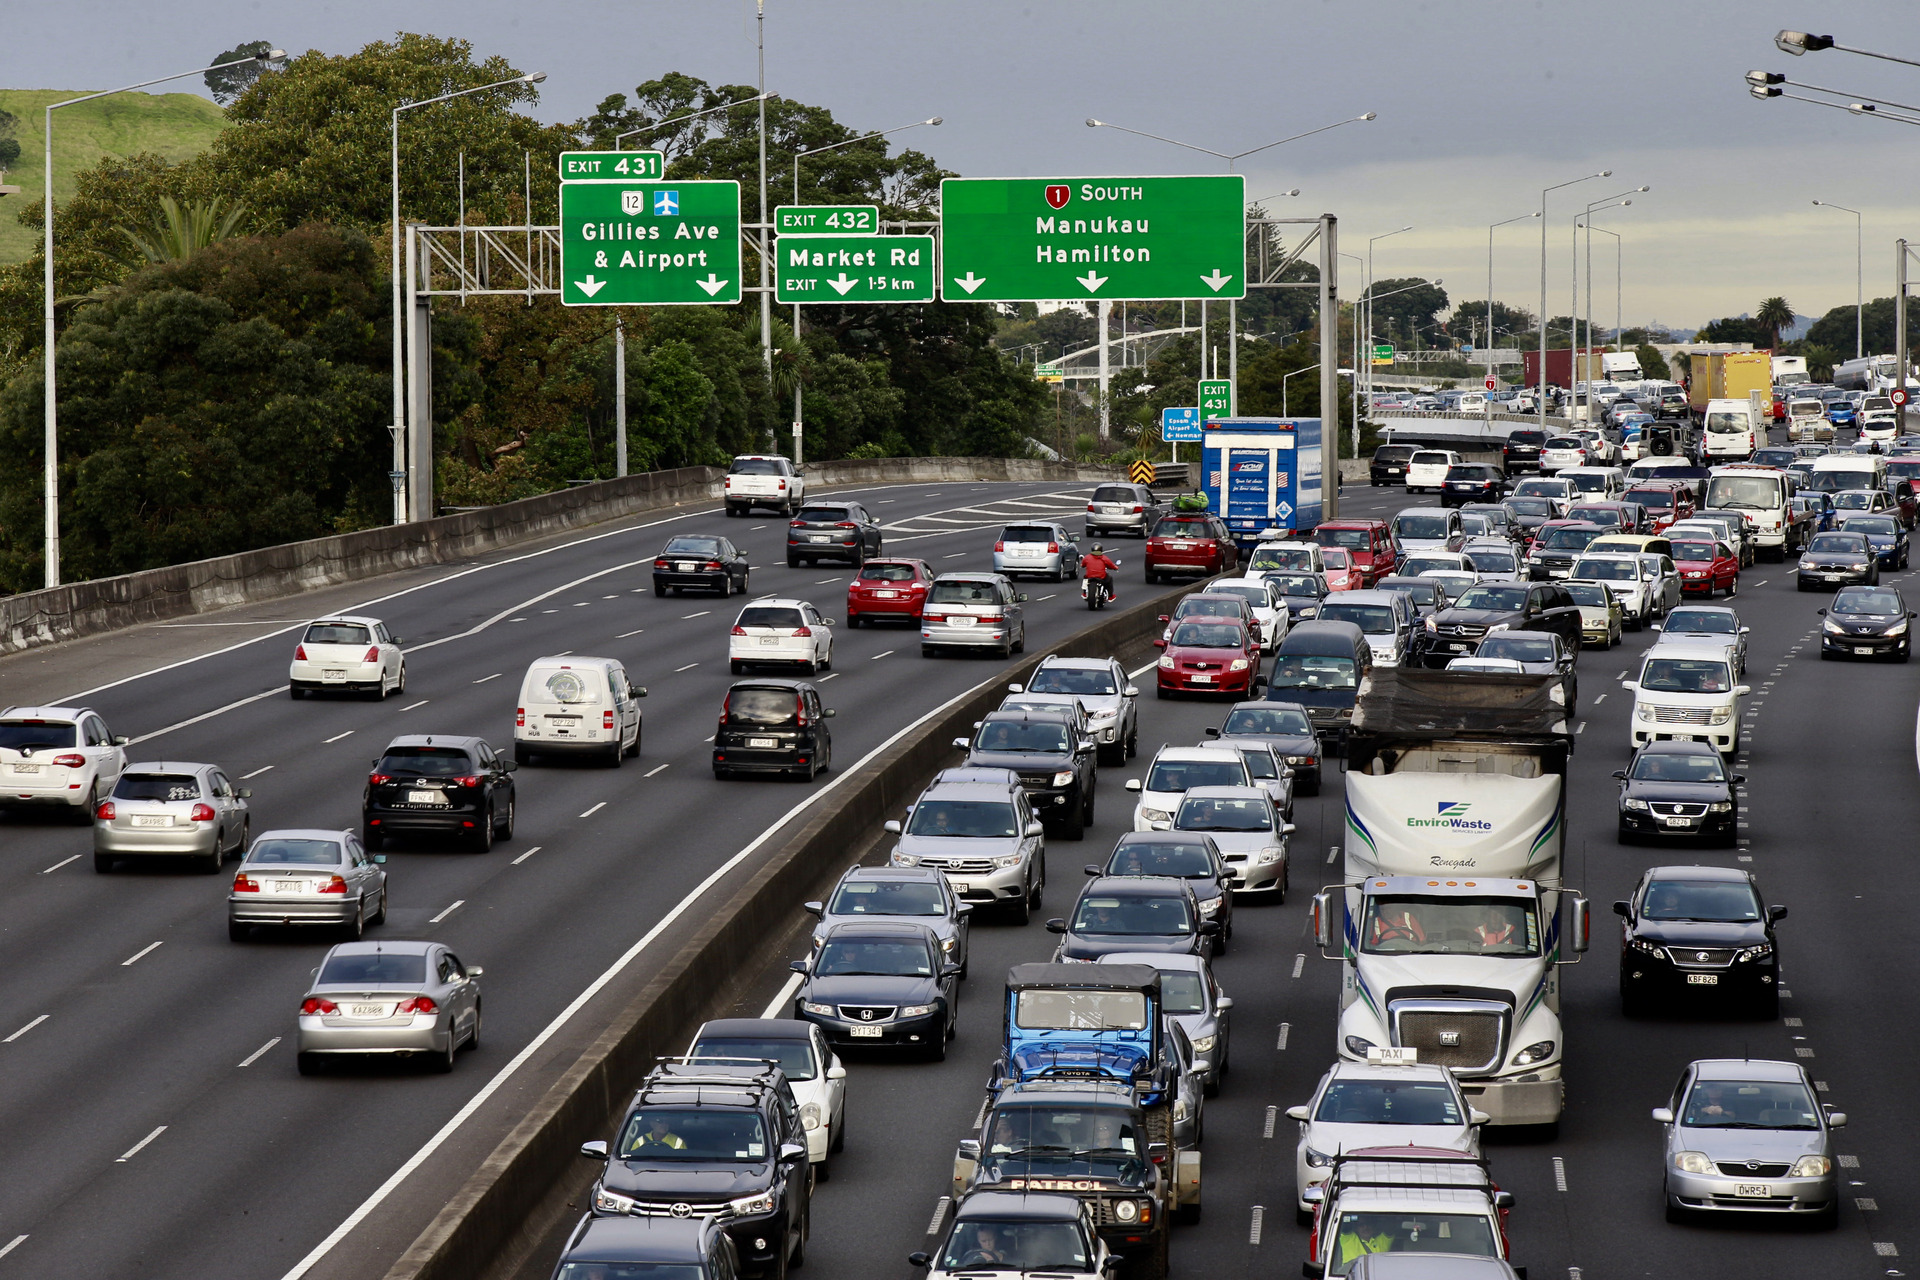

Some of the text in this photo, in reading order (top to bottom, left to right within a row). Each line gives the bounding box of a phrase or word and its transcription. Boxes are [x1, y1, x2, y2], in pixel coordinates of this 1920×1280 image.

[568, 157, 656, 175] EXIT 431
[626, 195, 639, 209] 12
[1055, 188, 1061, 202] 1
[783, 212, 871, 229] EXIT 432
[1036, 216, 1149, 234] Manukau
[582, 222, 720, 241] Gillies Ave
[594, 250, 708, 272] & Airport
[789, 248, 920, 267] Market Rd
[1036, 245, 1150, 263] Hamilton
[786, 279, 818, 291] EXIT
[891, 277, 915, 291] km
[1204, 386, 1226, 395] EXIT
[1204, 399, 1227, 409] 431
[1407, 817, 1492, 830] EnviroWaste
[1430, 855, 1476, 870] Renegade
[851, 1026, 882, 1036] BYT343
[1379, 1049, 1403, 1059] TAXI
[1010, 1178, 1107, 1191] PATROL
